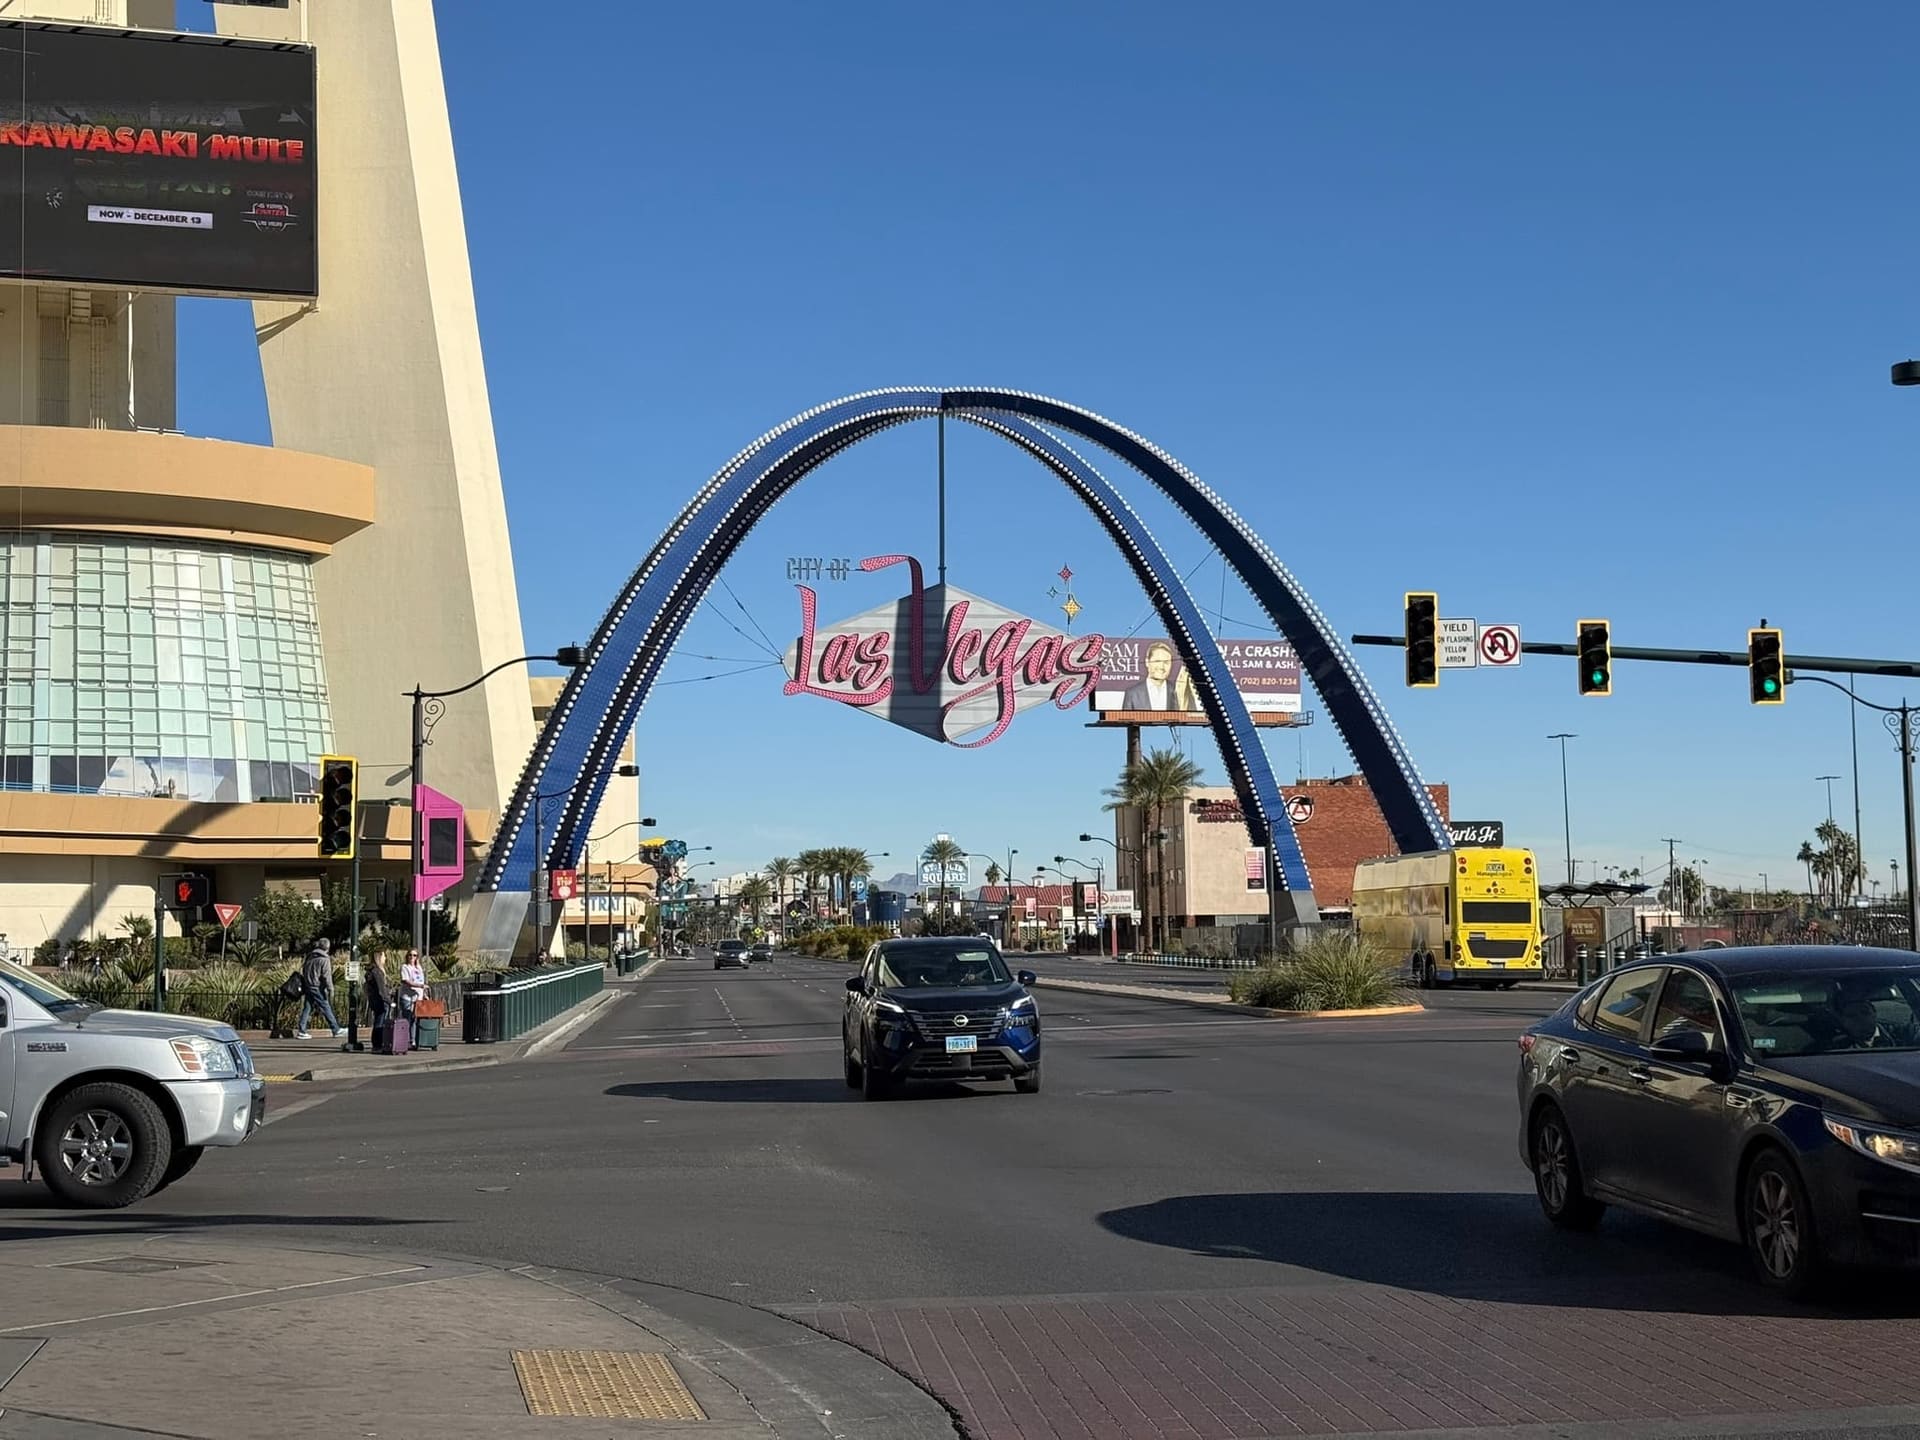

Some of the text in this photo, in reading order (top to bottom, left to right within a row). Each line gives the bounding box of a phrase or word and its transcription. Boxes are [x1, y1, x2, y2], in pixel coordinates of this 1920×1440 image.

[0, 120, 304, 163] KAWASAKI MULE
[99, 210, 124, 219] NOW
[134, 213, 188, 223] DECEMBER
[190, 216, 202, 225] 13
[786, 557, 850, 581] CITY OF
[1443, 623, 1468, 632] YIELD
[784, 554, 1105, 749] Las Vegas
[1101, 642, 1139, 658] SAM
[1231, 646, 1241, 657] A
[1104, 657, 1139, 672] ASH
[1242, 660, 1263, 668] SAM
[1265, 660, 1273, 669] &
[1275, 661, 1297, 669] ASH.
[1240, 677, 1297, 686] (702) 820-1234
[1451, 826, 1498, 843] arl's Jr.
[922, 872, 966, 883] SQUARE
